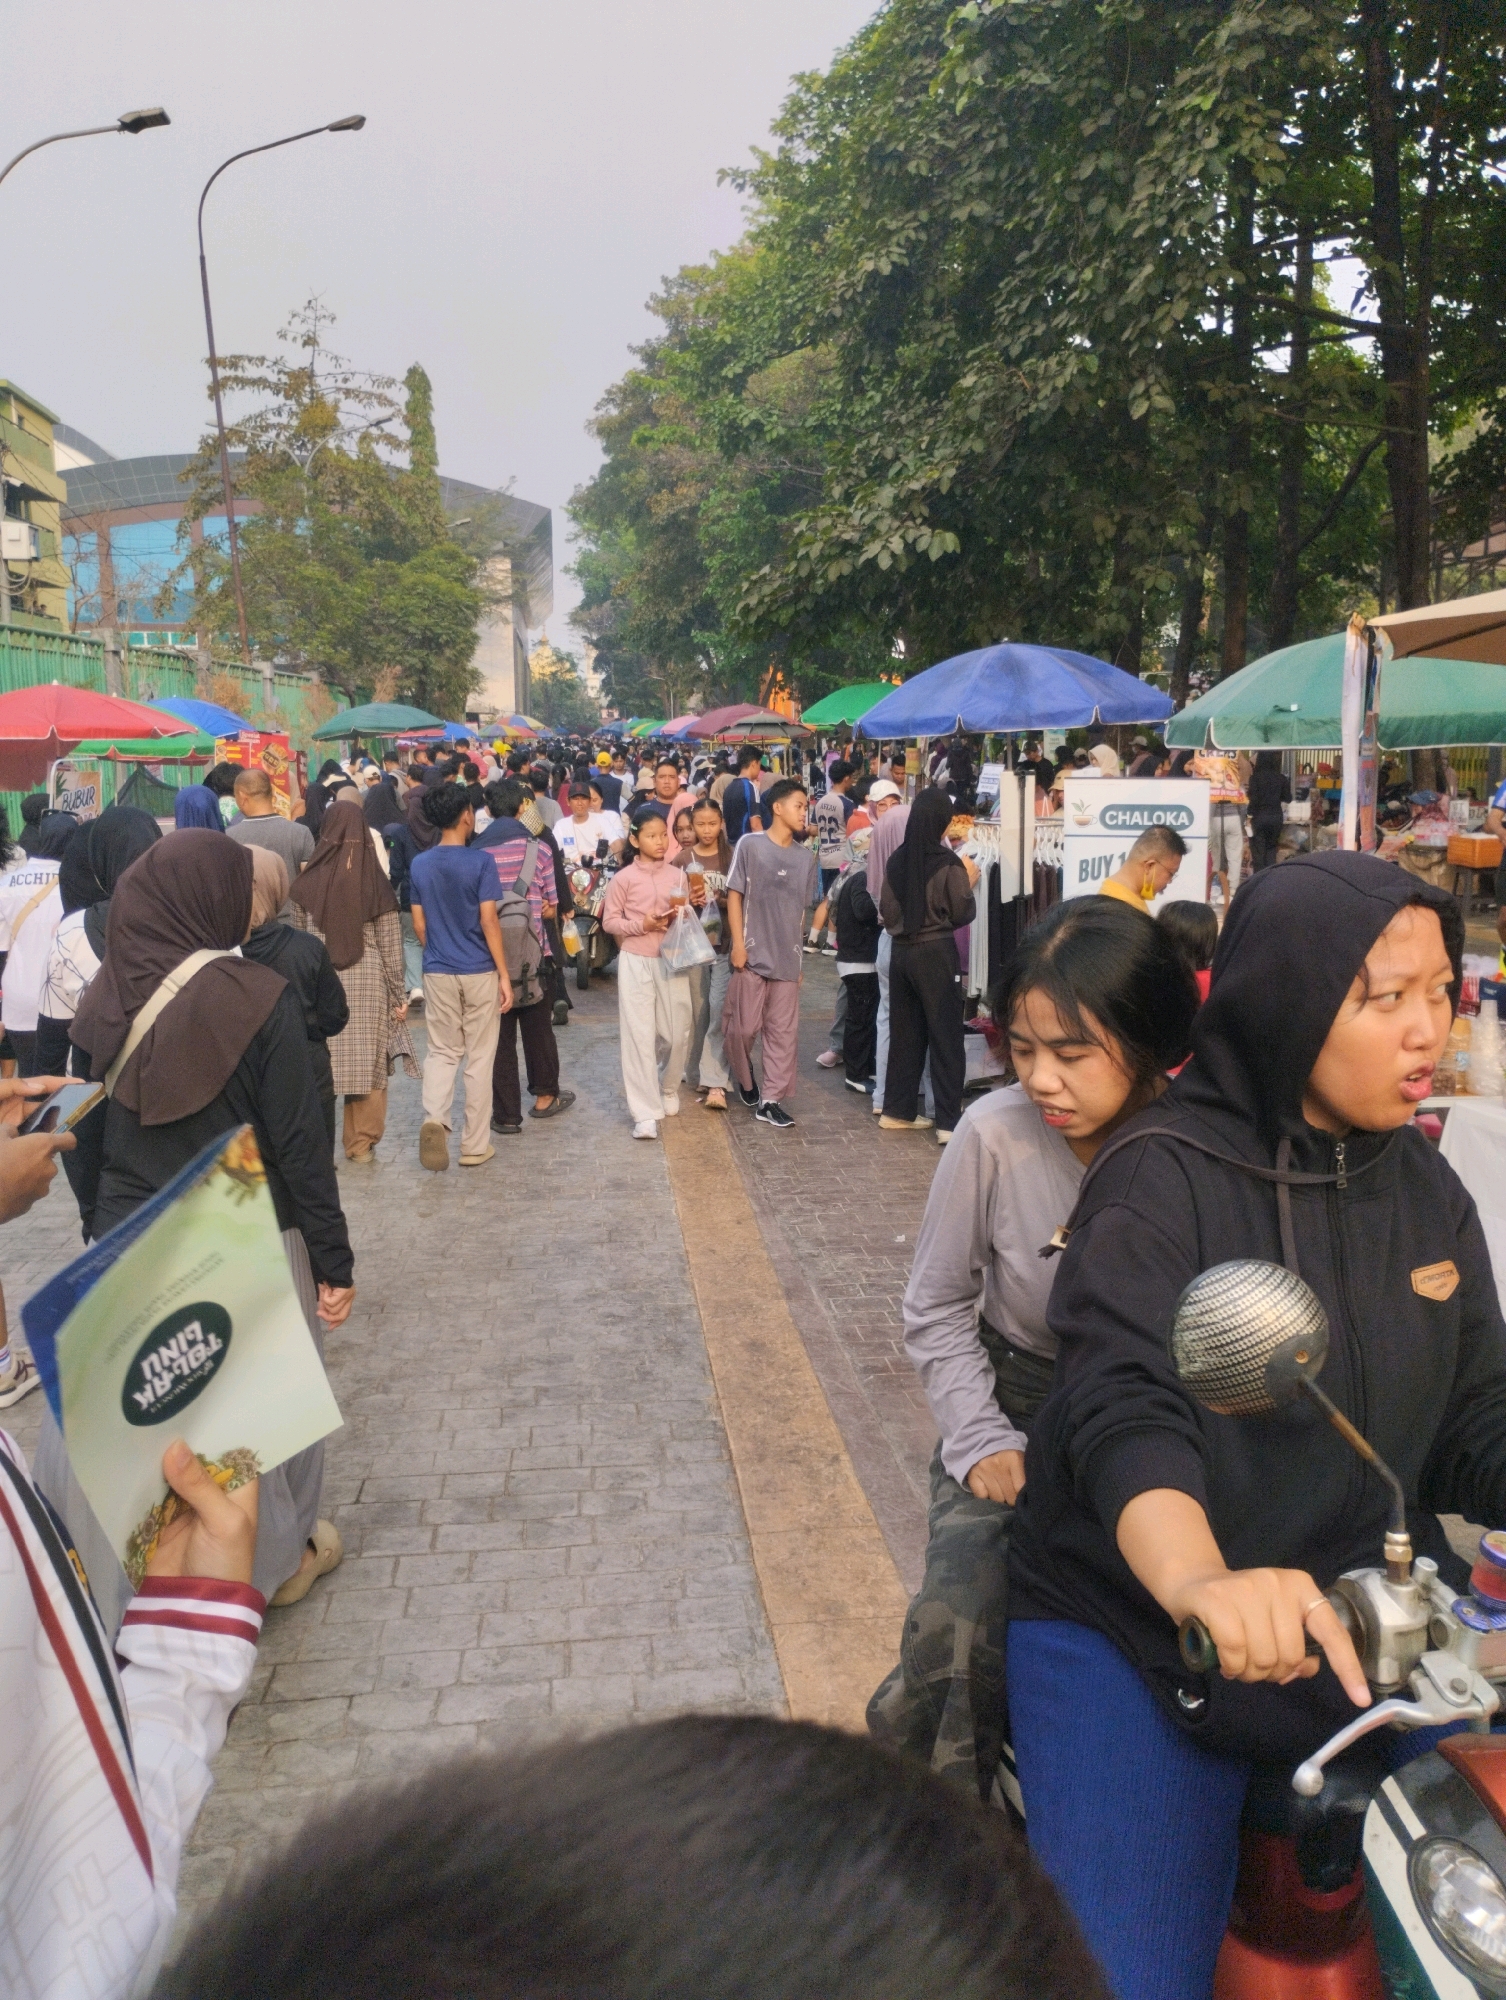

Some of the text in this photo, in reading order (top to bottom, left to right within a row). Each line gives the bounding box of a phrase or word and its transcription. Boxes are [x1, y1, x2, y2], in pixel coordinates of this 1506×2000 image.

[62, 786, 95, 810] BUBUR
[1105, 811, 1189, 825] CHALOKA
[1078, 853, 1115, 883] BUY
[141, 1320, 204, 1381] LINU
[132, 1333, 223, 1411] TOLAK
